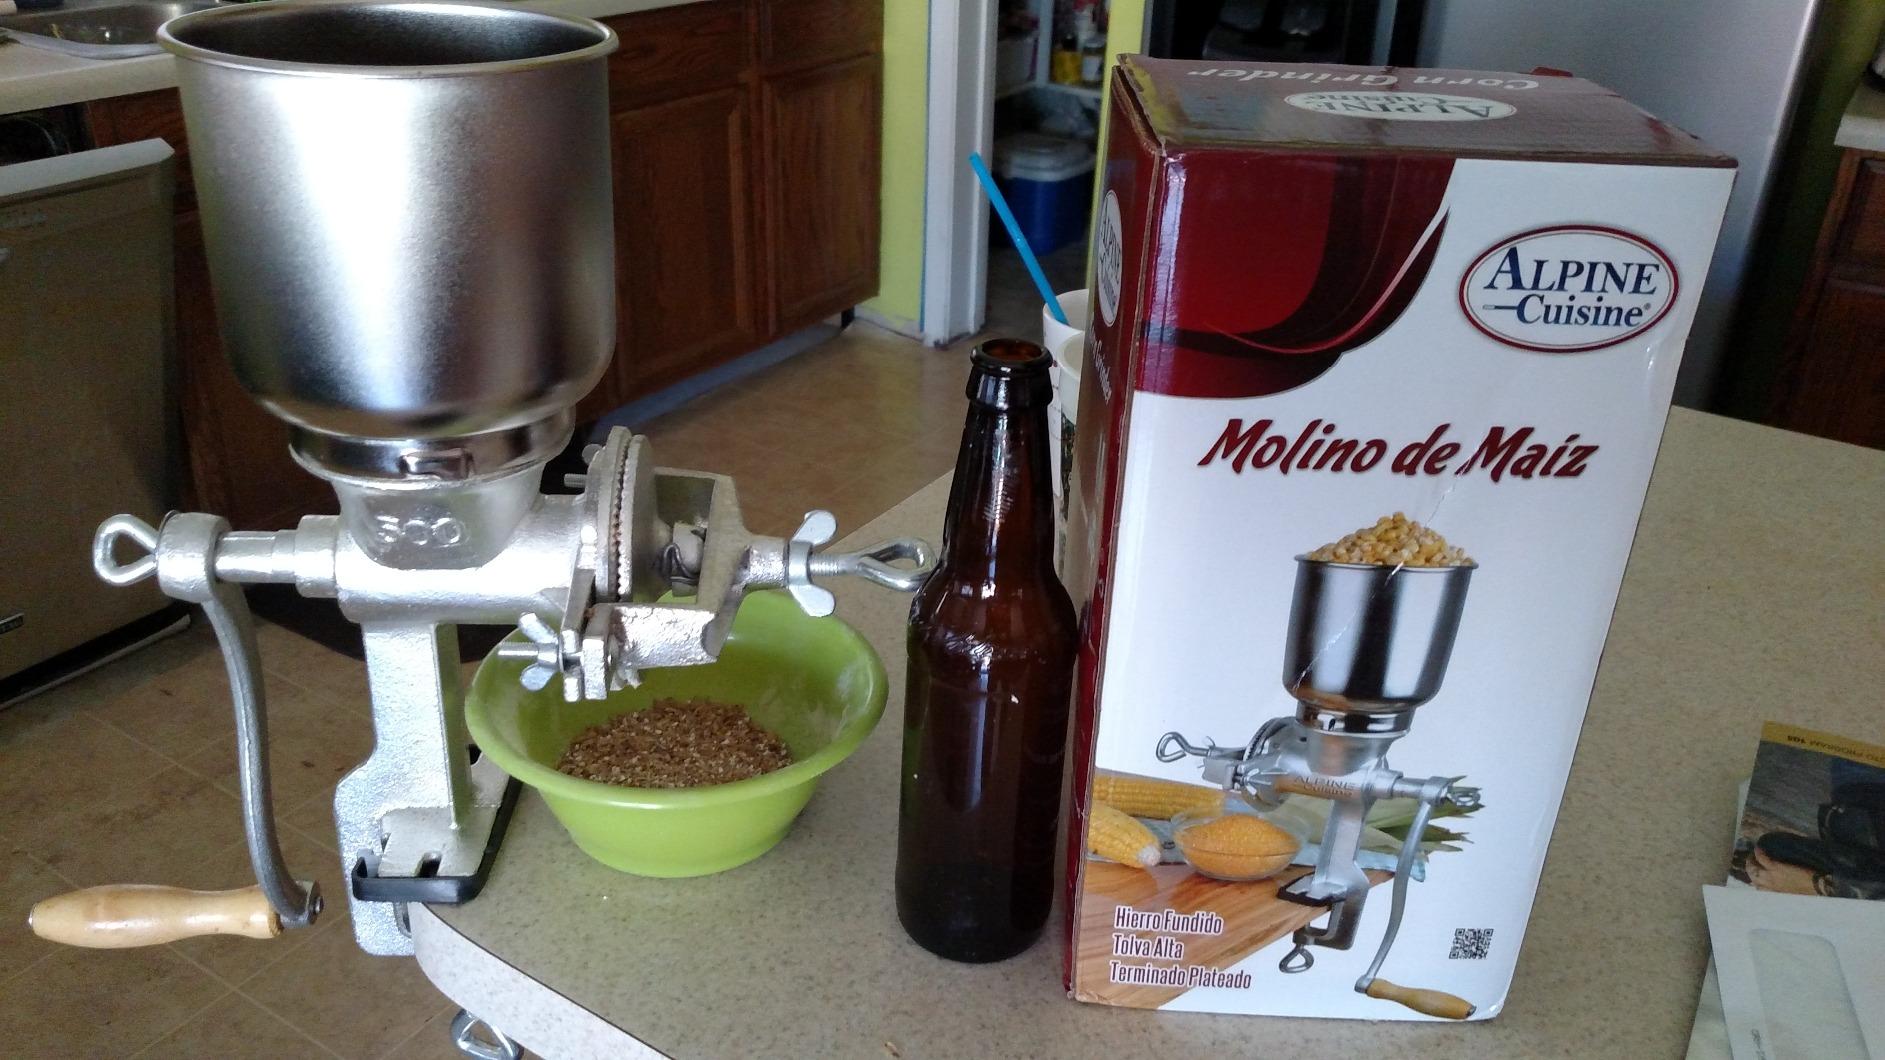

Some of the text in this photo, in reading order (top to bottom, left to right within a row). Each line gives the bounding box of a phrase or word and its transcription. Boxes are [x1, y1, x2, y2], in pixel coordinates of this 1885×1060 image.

[1187, 68, 1539, 89] Corn Grinder
[1483, 246, 1660, 295] ALPINE
[1197, 418, 1599, 482] Molino de Maíz
[1115, 907, 1223, 934] Hierro Fundido
[1113, 934, 1184, 959] Tolva Alta
[1110, 961, 1252, 989] Terminado Plateado
